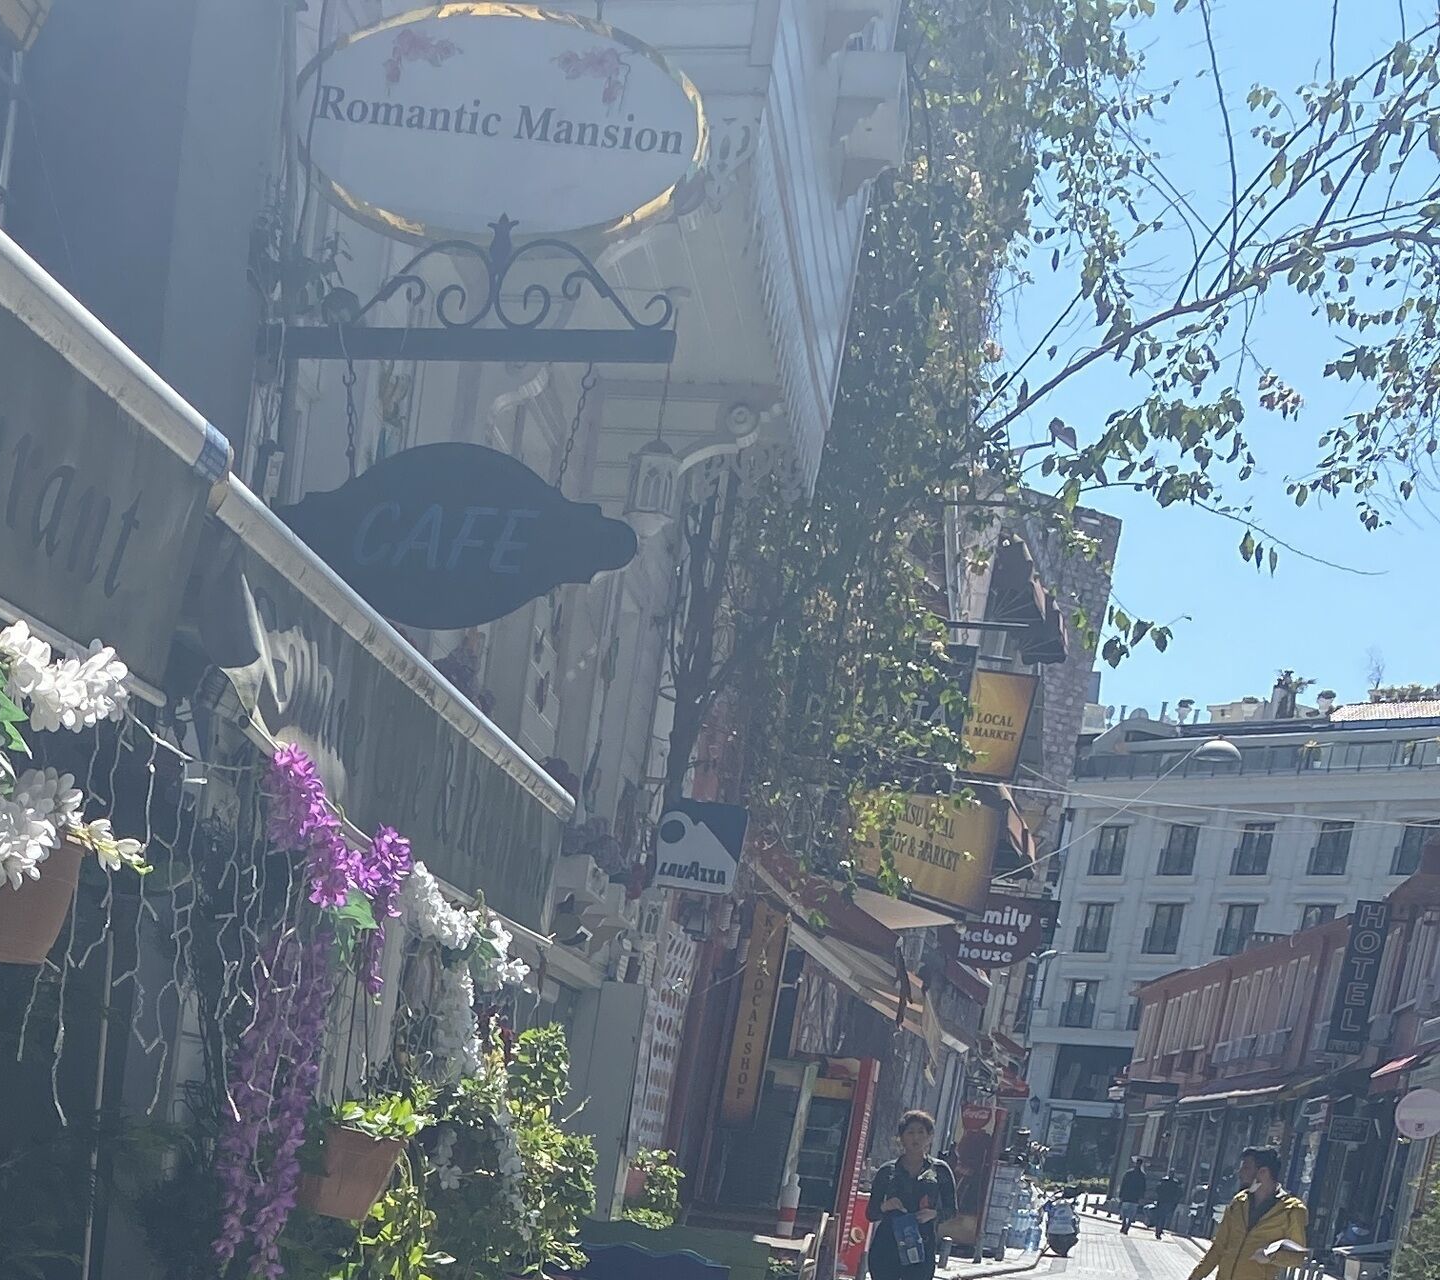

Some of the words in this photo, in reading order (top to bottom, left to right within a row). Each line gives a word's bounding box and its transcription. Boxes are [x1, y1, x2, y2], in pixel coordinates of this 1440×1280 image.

[317, 84, 502, 138] Romantic
[513, 104, 684, 155] Mansion
[352, 501, 541, 574] CAFE
[976, 712, 1014, 728] LOCAL
[973, 727, 1017, 742] MARKET
[658, 861, 726, 885] LAVAZZA
[983, 905, 1032, 933] mily
[960, 928, 1018, 946] kebab
[958, 943, 1013, 963] house
[1340, 903, 1387, 1032] HOTEL
[736, 1042, 753, 1099] SHOP
